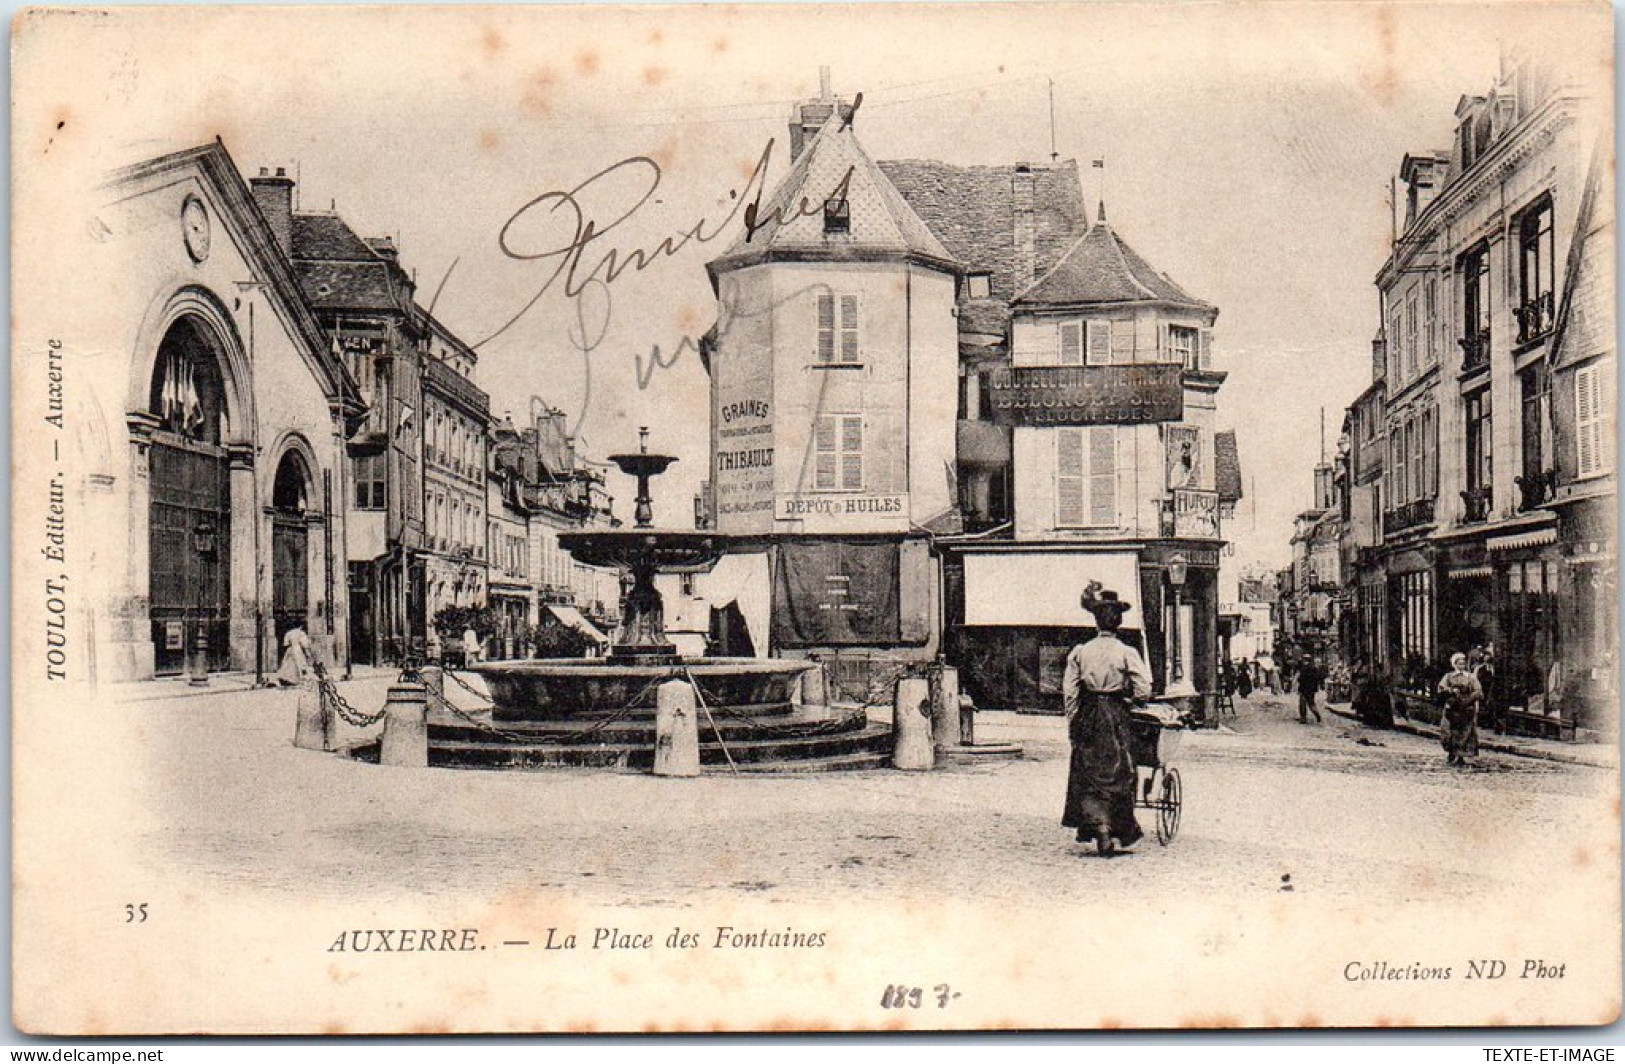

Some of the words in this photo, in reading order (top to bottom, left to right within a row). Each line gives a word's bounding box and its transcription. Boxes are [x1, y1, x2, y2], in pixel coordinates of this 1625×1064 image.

[44, 338, 64, 429] Auxerre
[722, 399, 769, 422] GRAINES
[717, 448, 774, 471] THIBAULT
[41, 470, 65, 563] Éditeur.
[845, 497, 902, 513] HUILES
[46, 572, 69, 681] TOULOT,
[125, 903, 149, 923] 35
[327, 929, 488, 952] AUXERRE.
[544, 927, 577, 950] La
[592, 927, 654, 950] Place
[665, 926, 701, 949] des
[713, 926, 828, 949] Fontaines
[1343, 961, 1453, 982] Collections
[1464, 959, 1507, 980] ND
[1520, 958, 1567, 979] Phot
